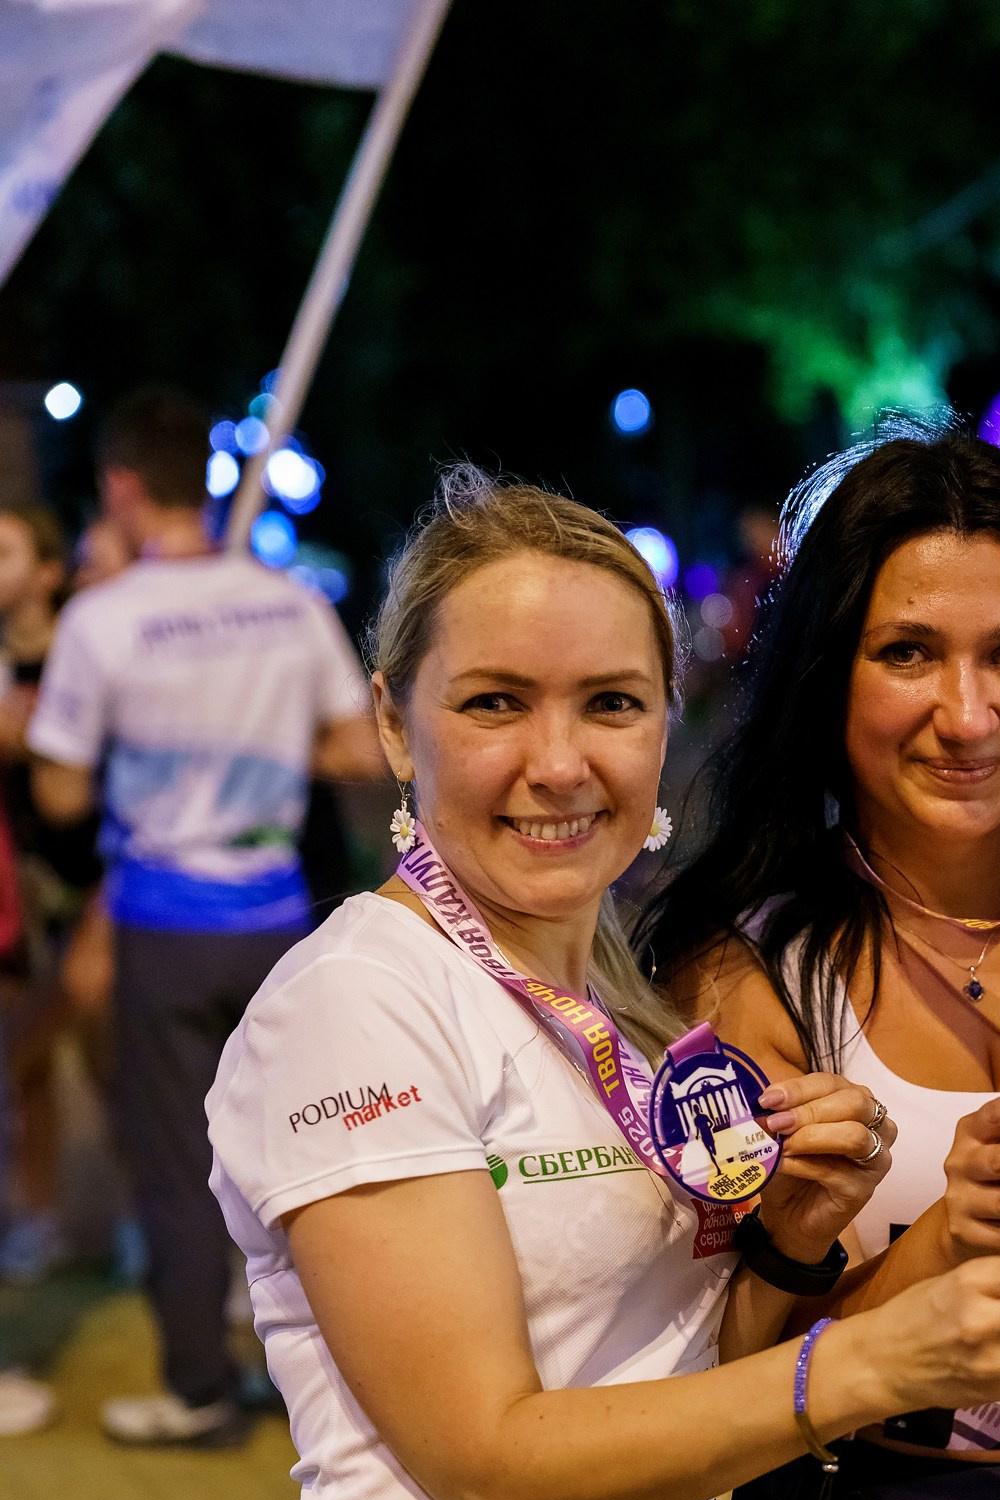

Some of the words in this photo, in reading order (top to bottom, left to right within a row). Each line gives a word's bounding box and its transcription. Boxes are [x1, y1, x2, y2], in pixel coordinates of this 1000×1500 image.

[456, 926, 517, 978] ТВОЯ
[583, 1021, 620, 1100] ТВОЯ
[288, 1081, 391, 1133] PODIUM
[341, 1084, 423, 1132] market
[518, 1144, 643, 1179] СБЕРБАН
[740, 1150, 764, 1163] СПОРТ
[763, 1146, 773, 1155] 40
[710, 1175, 731, 1192] ЗАБЕГ
